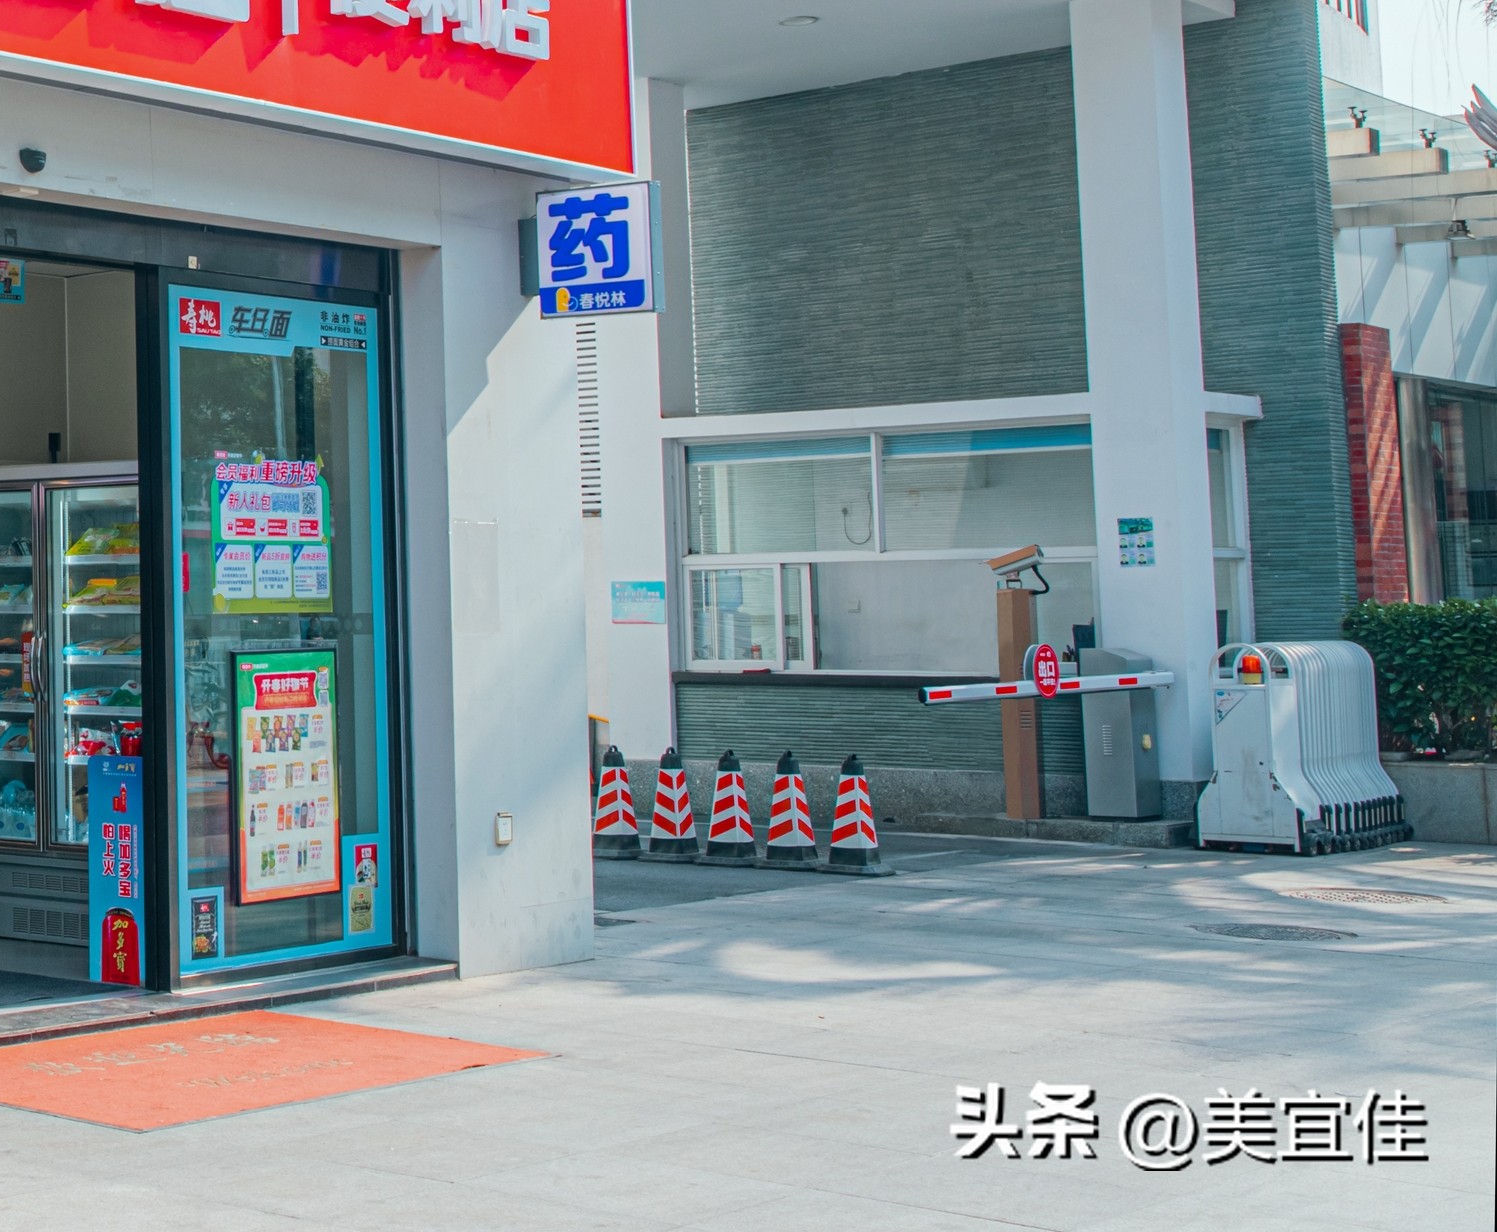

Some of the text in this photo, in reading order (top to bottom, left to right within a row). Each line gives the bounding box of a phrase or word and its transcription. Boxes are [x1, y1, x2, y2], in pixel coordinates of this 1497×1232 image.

[548, 193, 631, 282] 药
[579, 290, 626, 309] 春悦林
[320, 310, 350, 324] 非油炸
[320, 325, 351, 334] NON-FRIED
[216, 460, 316, 484] 会员福利重磅升级
[228, 492, 271, 511] 新人礼包
[1038, 660, 1055, 677] 出口
